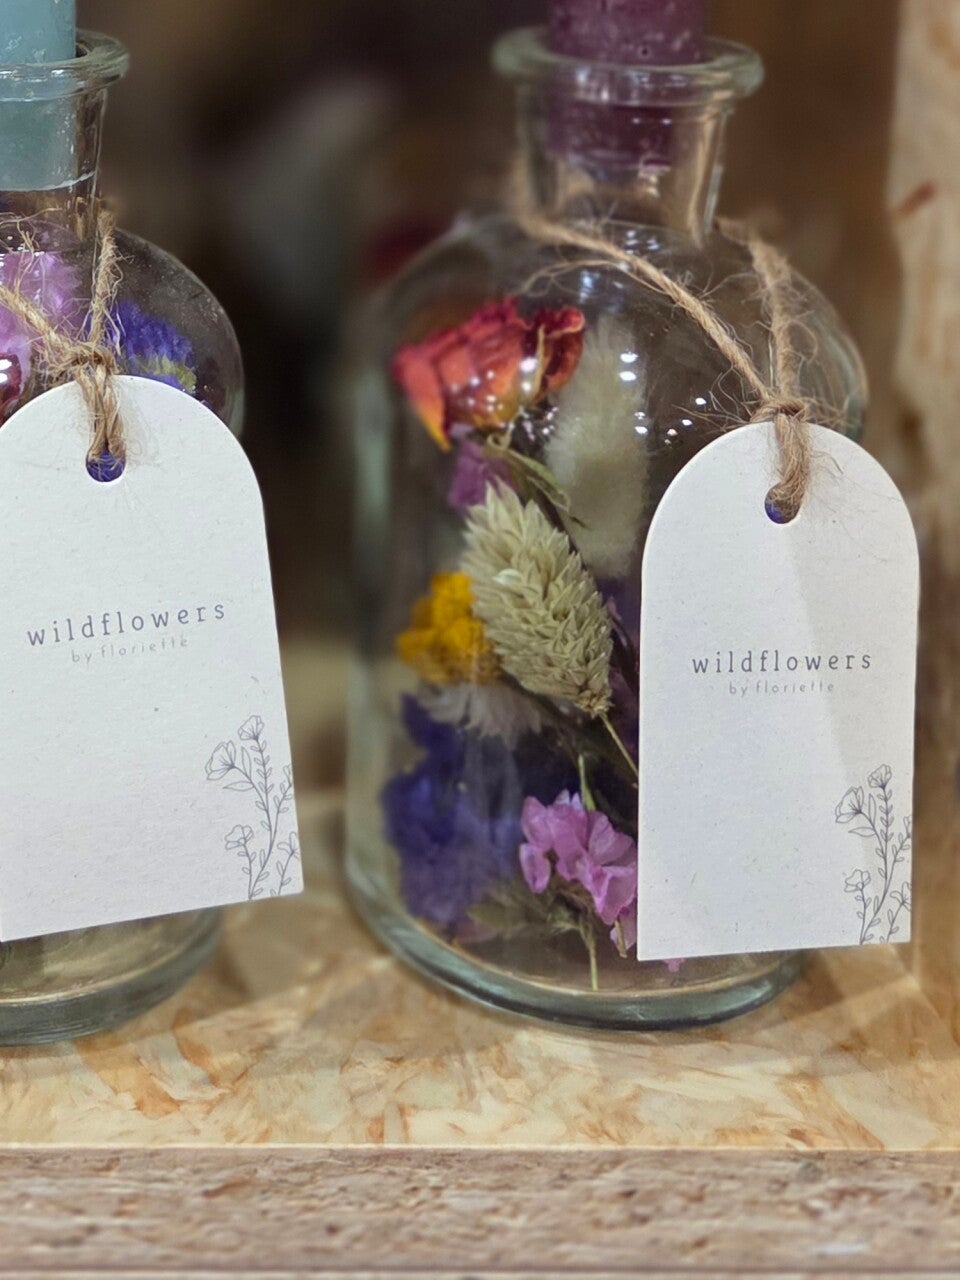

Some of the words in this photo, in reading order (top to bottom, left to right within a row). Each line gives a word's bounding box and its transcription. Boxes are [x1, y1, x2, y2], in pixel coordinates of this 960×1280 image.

[27, 603, 225, 646] wildflowers
[71, 649, 93, 664] by
[100, 637, 188, 658] floriette
[692, 650, 871, 674] wildflowers
[729, 681, 749, 698] by
[755, 680, 835, 694] floriette
